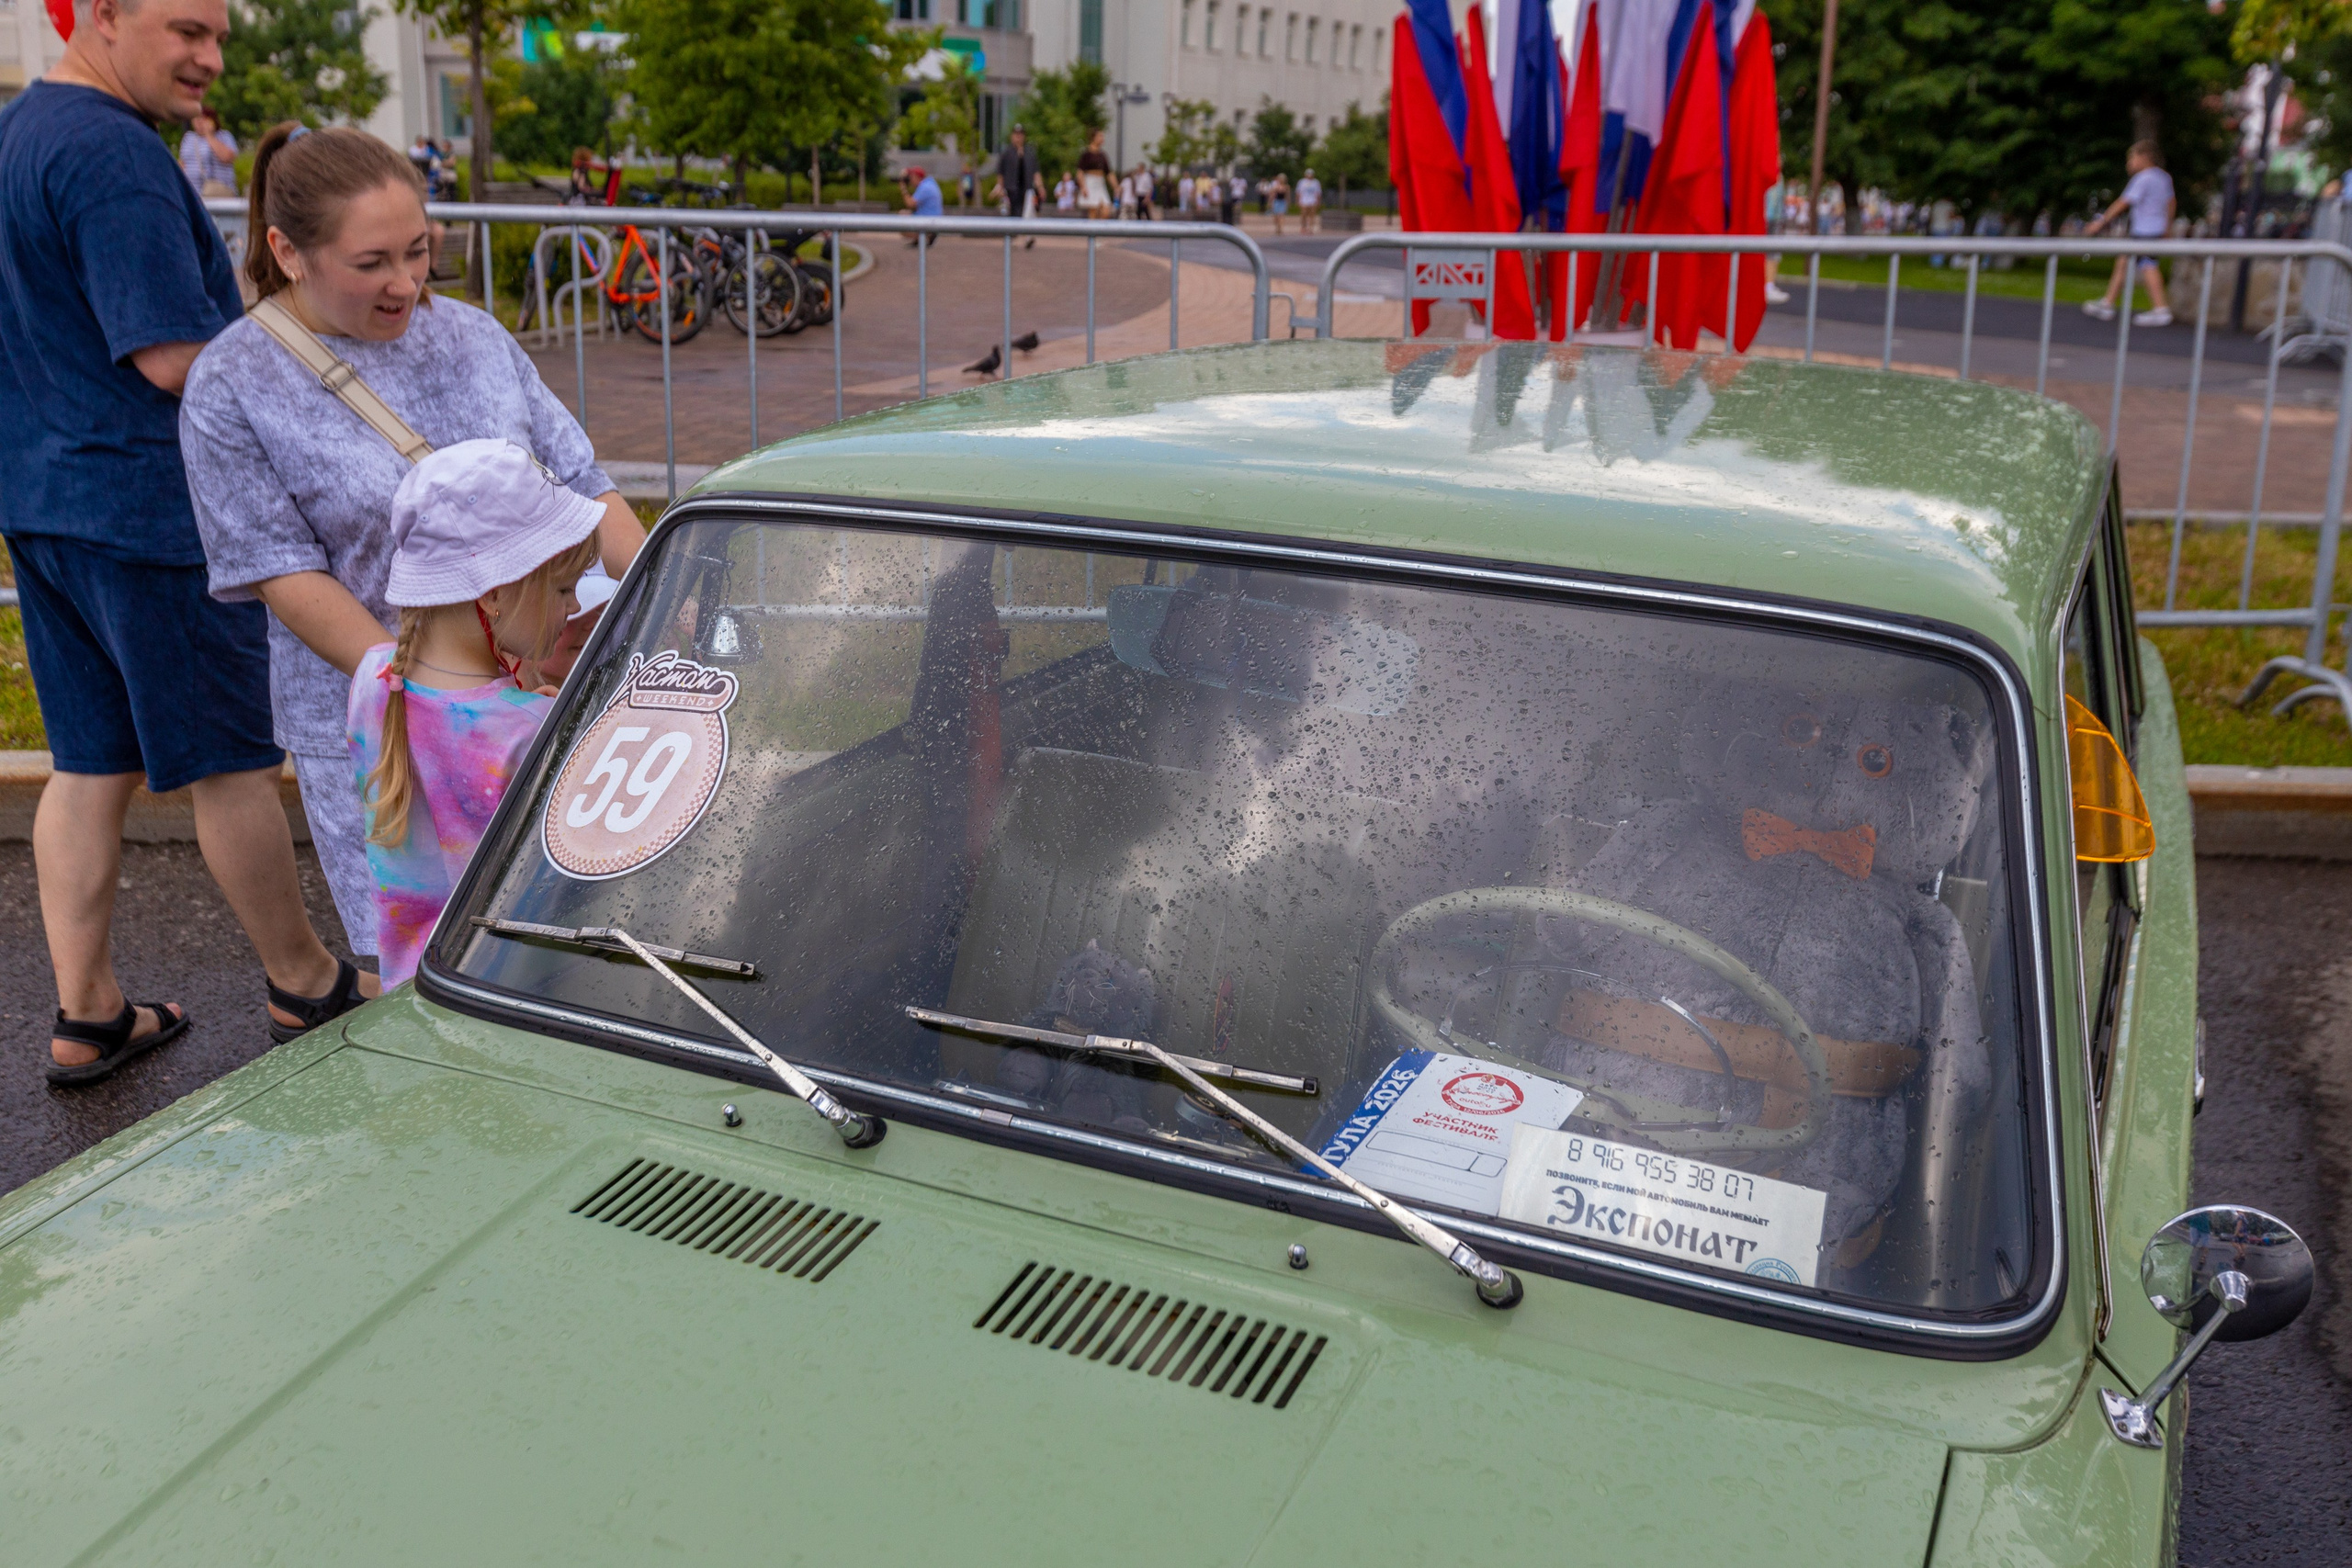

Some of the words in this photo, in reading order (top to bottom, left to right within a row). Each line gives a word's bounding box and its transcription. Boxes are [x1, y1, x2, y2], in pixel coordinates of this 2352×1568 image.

[642, 694, 707, 706] WEEKEND
[565, 726, 693, 834] 59
[1364, 1069, 1419, 1111] 2026
[1422, 1111, 1498, 1134] УЧАСТНИК
[1566, 1138, 1583, 1163] 8
[1592, 1144, 1624, 1171] 916
[1635, 1153, 1678, 1184] 955
[1687, 1164, 1715, 1193] 38
[1724, 1173, 1754, 1202] 07
[1601, 1181, 1626, 1194] ЕСЛИ
[1626, 1185, 1647, 1198] МОЙ
[1647, 1190, 1709, 1213] АВТОМОБИЛЬ
[1709, 1205, 1731, 1218] ВАМ
[1730, 1210, 1770, 1227] МЕШАЕТ
